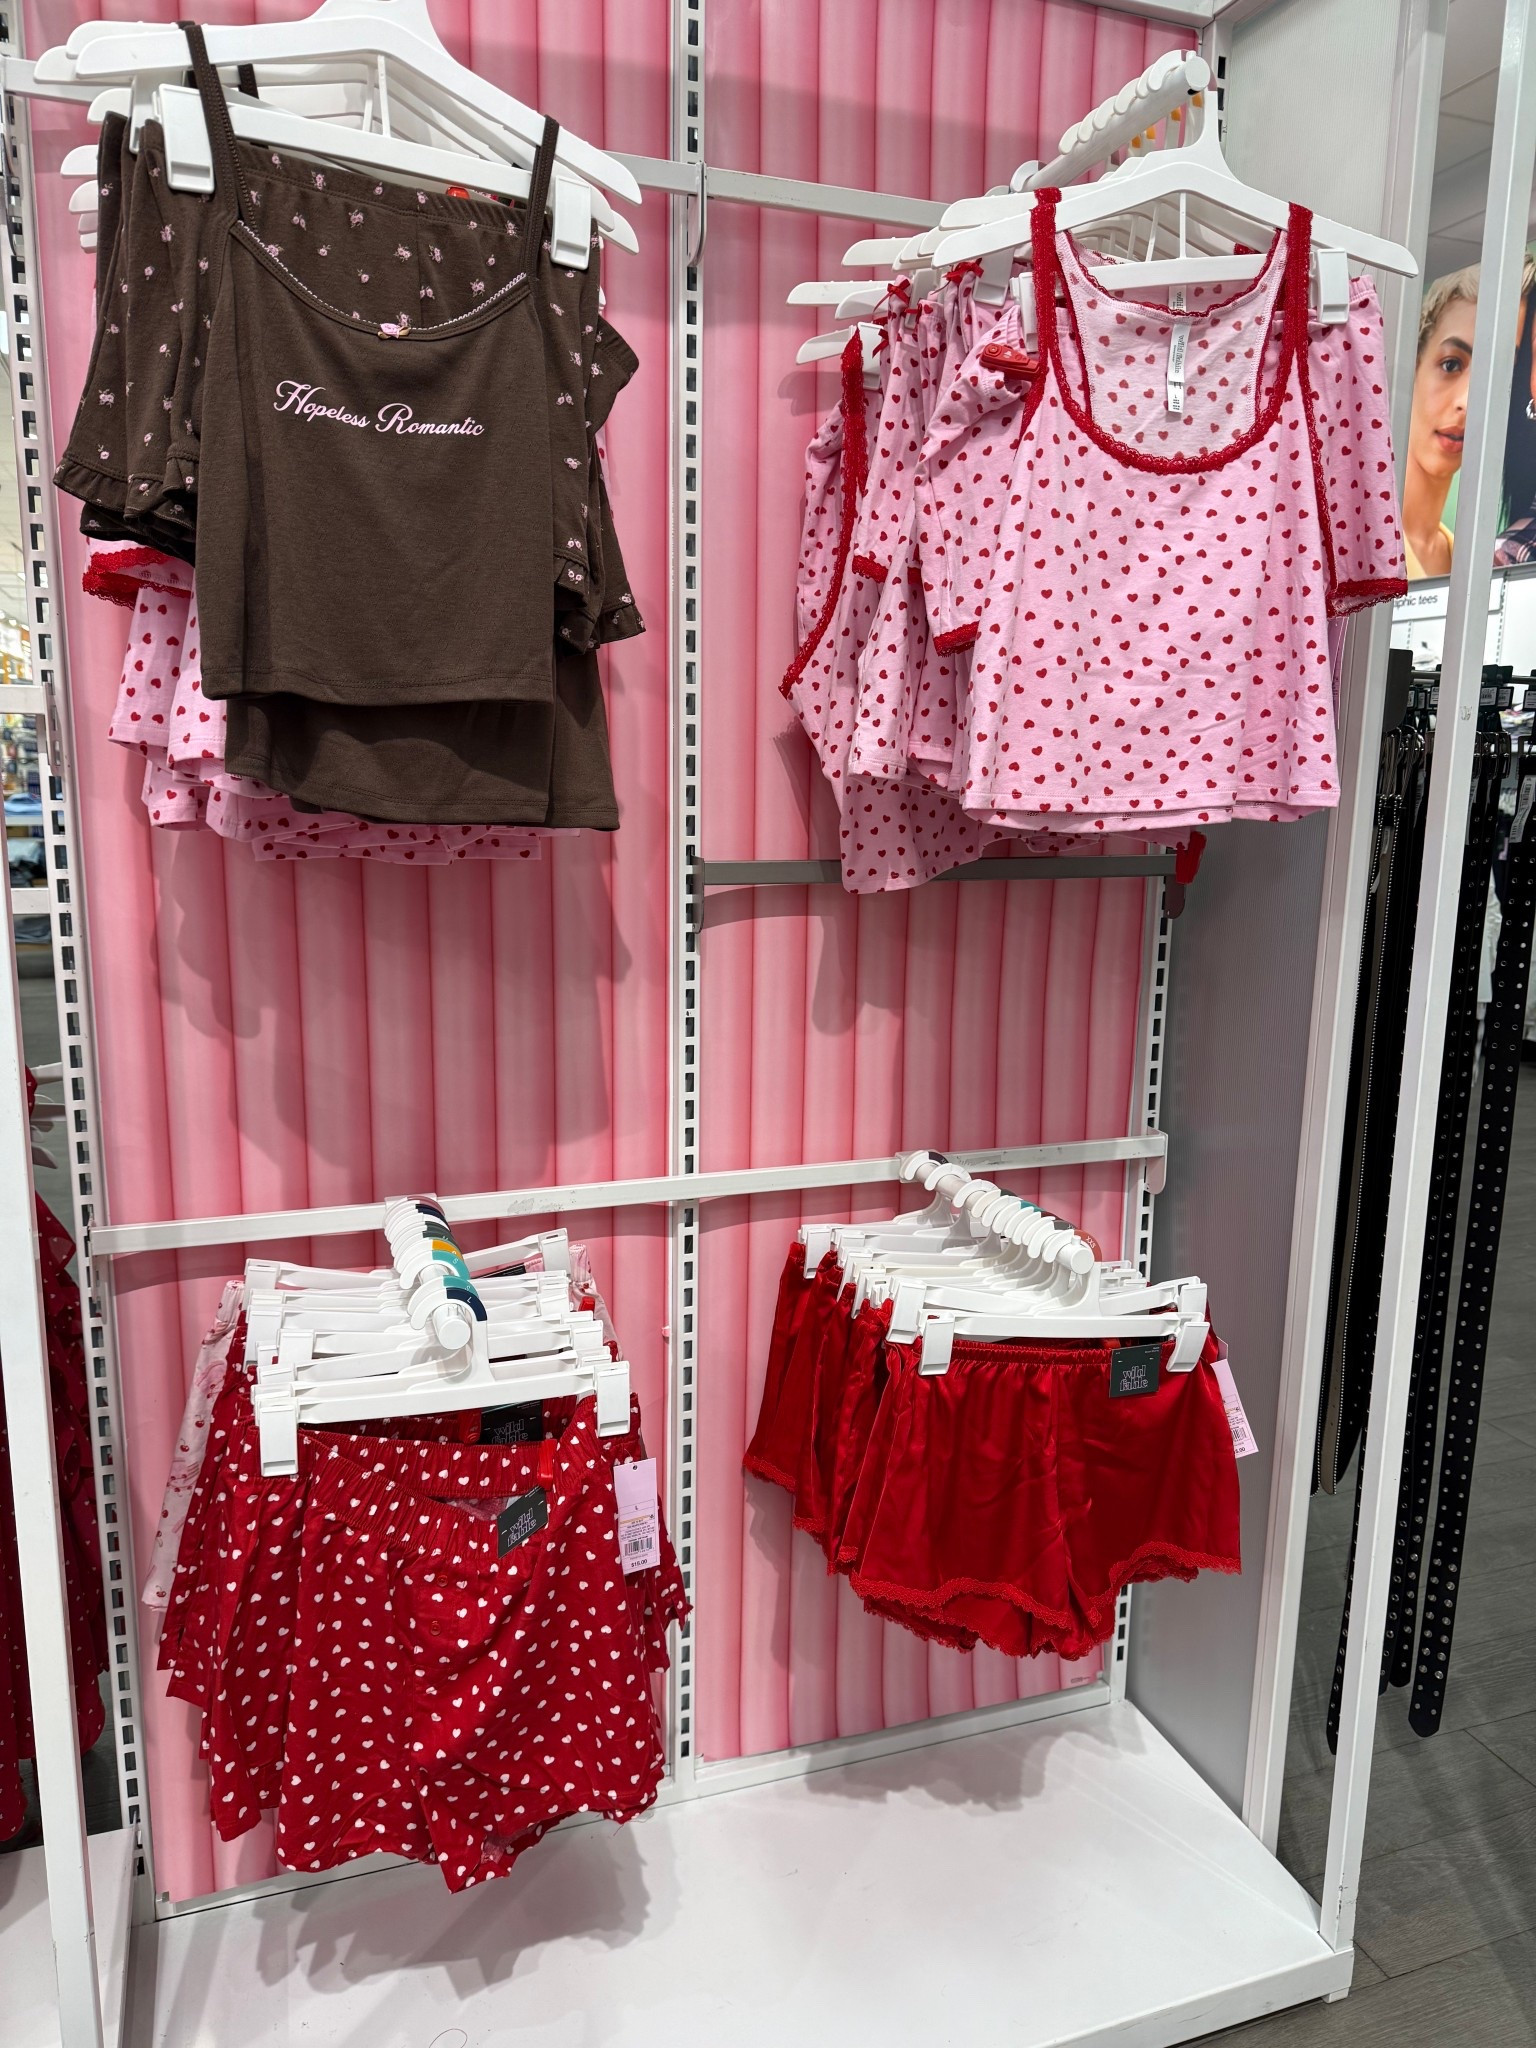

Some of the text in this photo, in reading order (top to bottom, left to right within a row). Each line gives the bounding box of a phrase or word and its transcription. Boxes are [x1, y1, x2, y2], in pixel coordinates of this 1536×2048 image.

[273, 380, 485, 436] Hopeless Romantic
[1418, 594, 1438, 605] tees
[1086, 1235, 1096, 1248] XXS
[466, 1296, 472, 1304] L
[1123, 1365, 1146, 1379] wild
[1119, 1377, 1148, 1391] fable
[494, 1418, 525, 1436] wild
[509, 1507, 534, 1535] wild
[507, 1519, 537, 1548] fable
